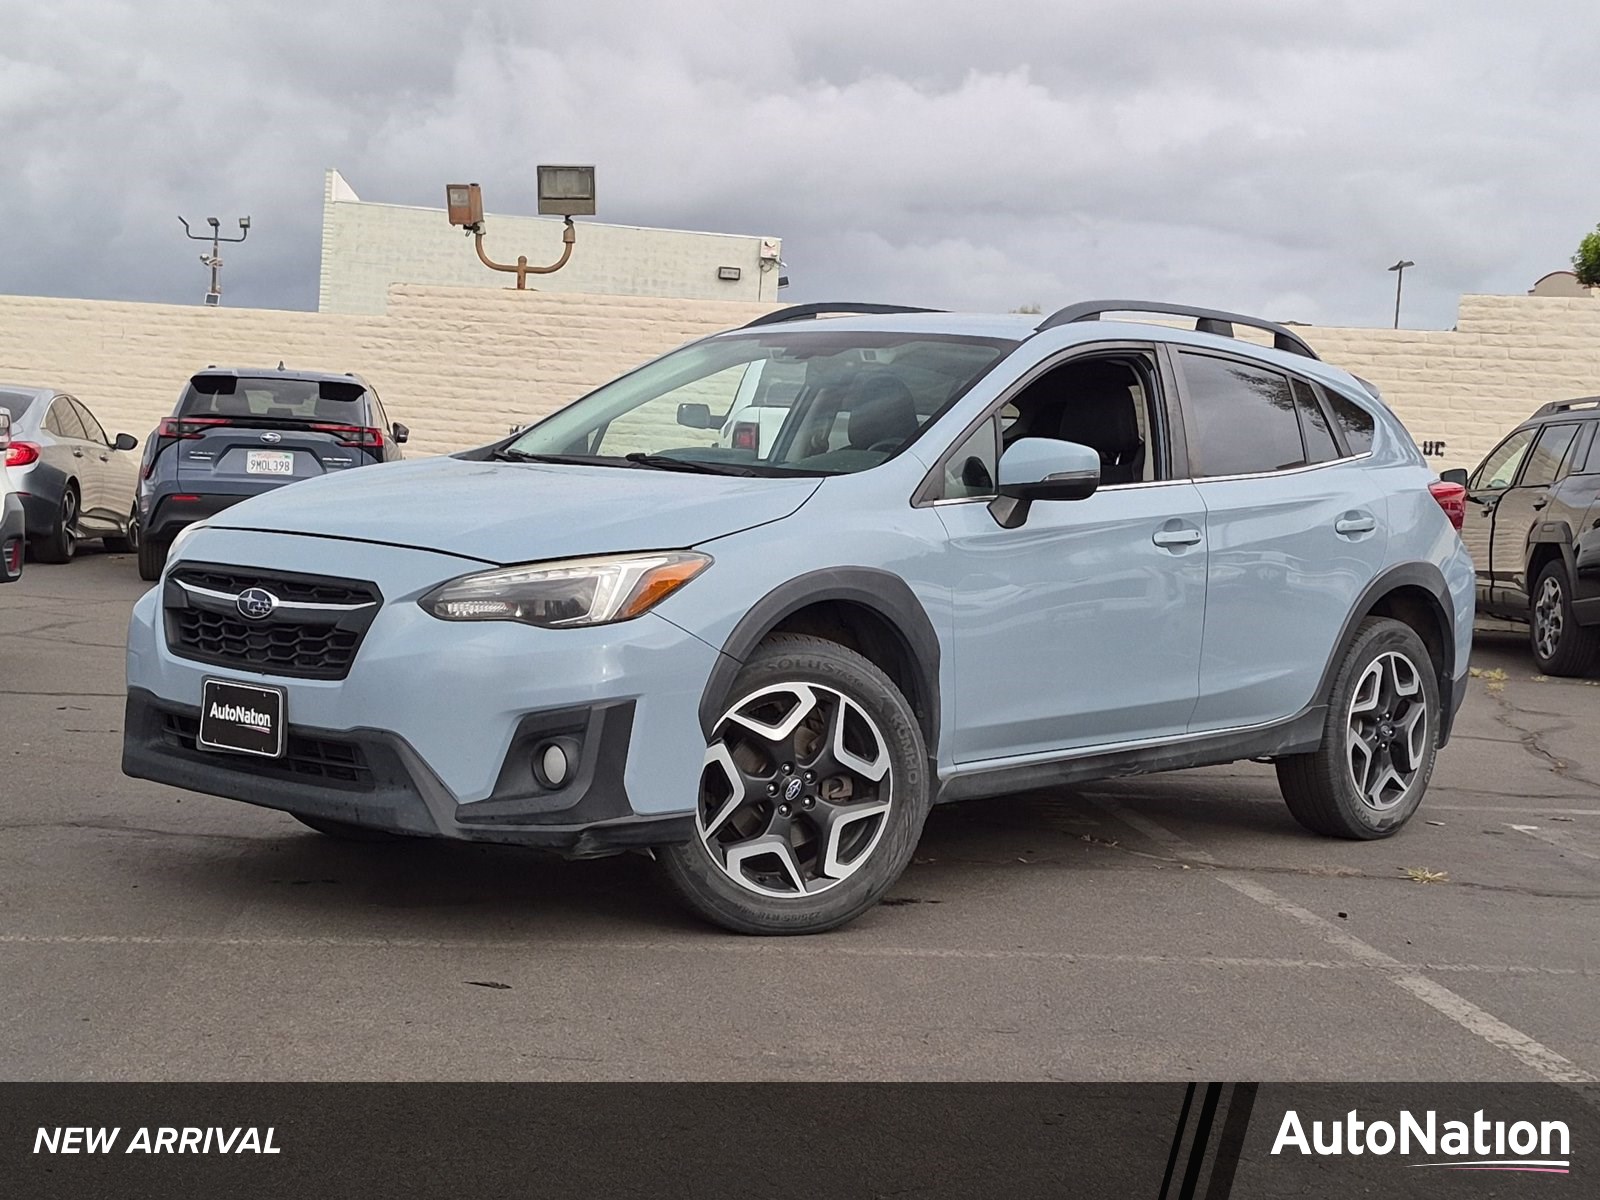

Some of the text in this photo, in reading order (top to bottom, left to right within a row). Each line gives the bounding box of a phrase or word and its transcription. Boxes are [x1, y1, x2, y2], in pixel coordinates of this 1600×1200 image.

[766, 658, 834, 673] SOLUS
[209, 701, 272, 728] AutoNation
[891, 713, 917, 785] KUMHO
